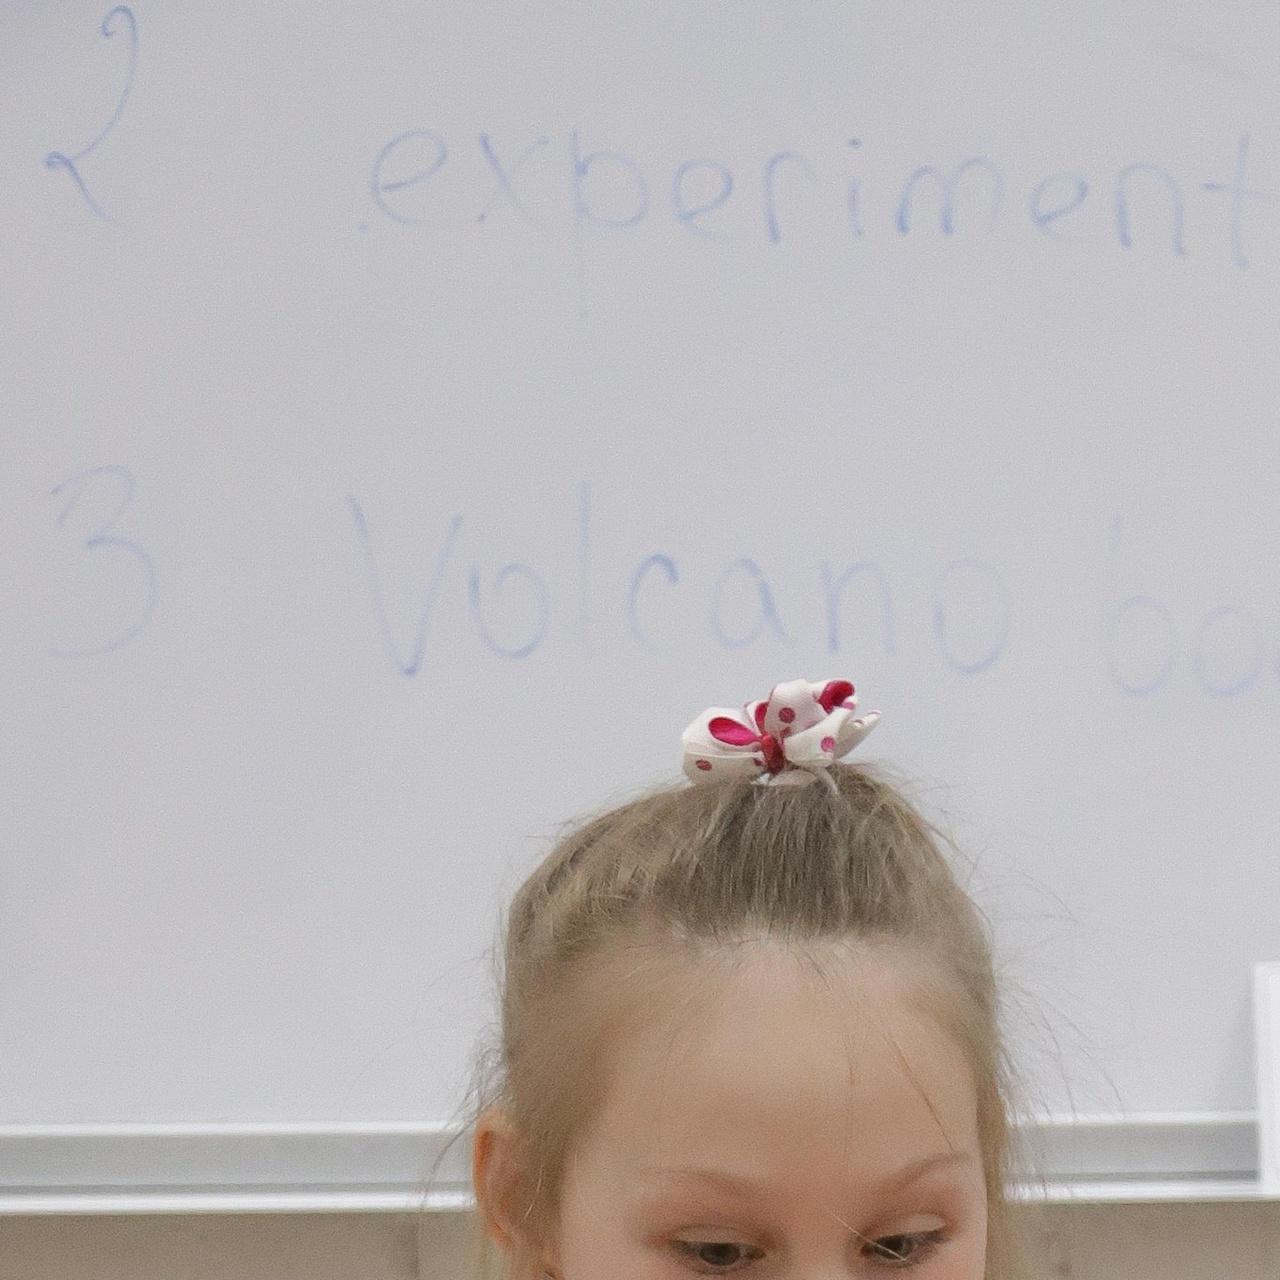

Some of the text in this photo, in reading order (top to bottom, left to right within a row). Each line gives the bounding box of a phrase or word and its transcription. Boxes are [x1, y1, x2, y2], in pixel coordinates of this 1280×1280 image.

[44, 5, 138, 226] 2
[50, 464, 158, 661] 3
[350, 482, 1012, 678] Volcano
